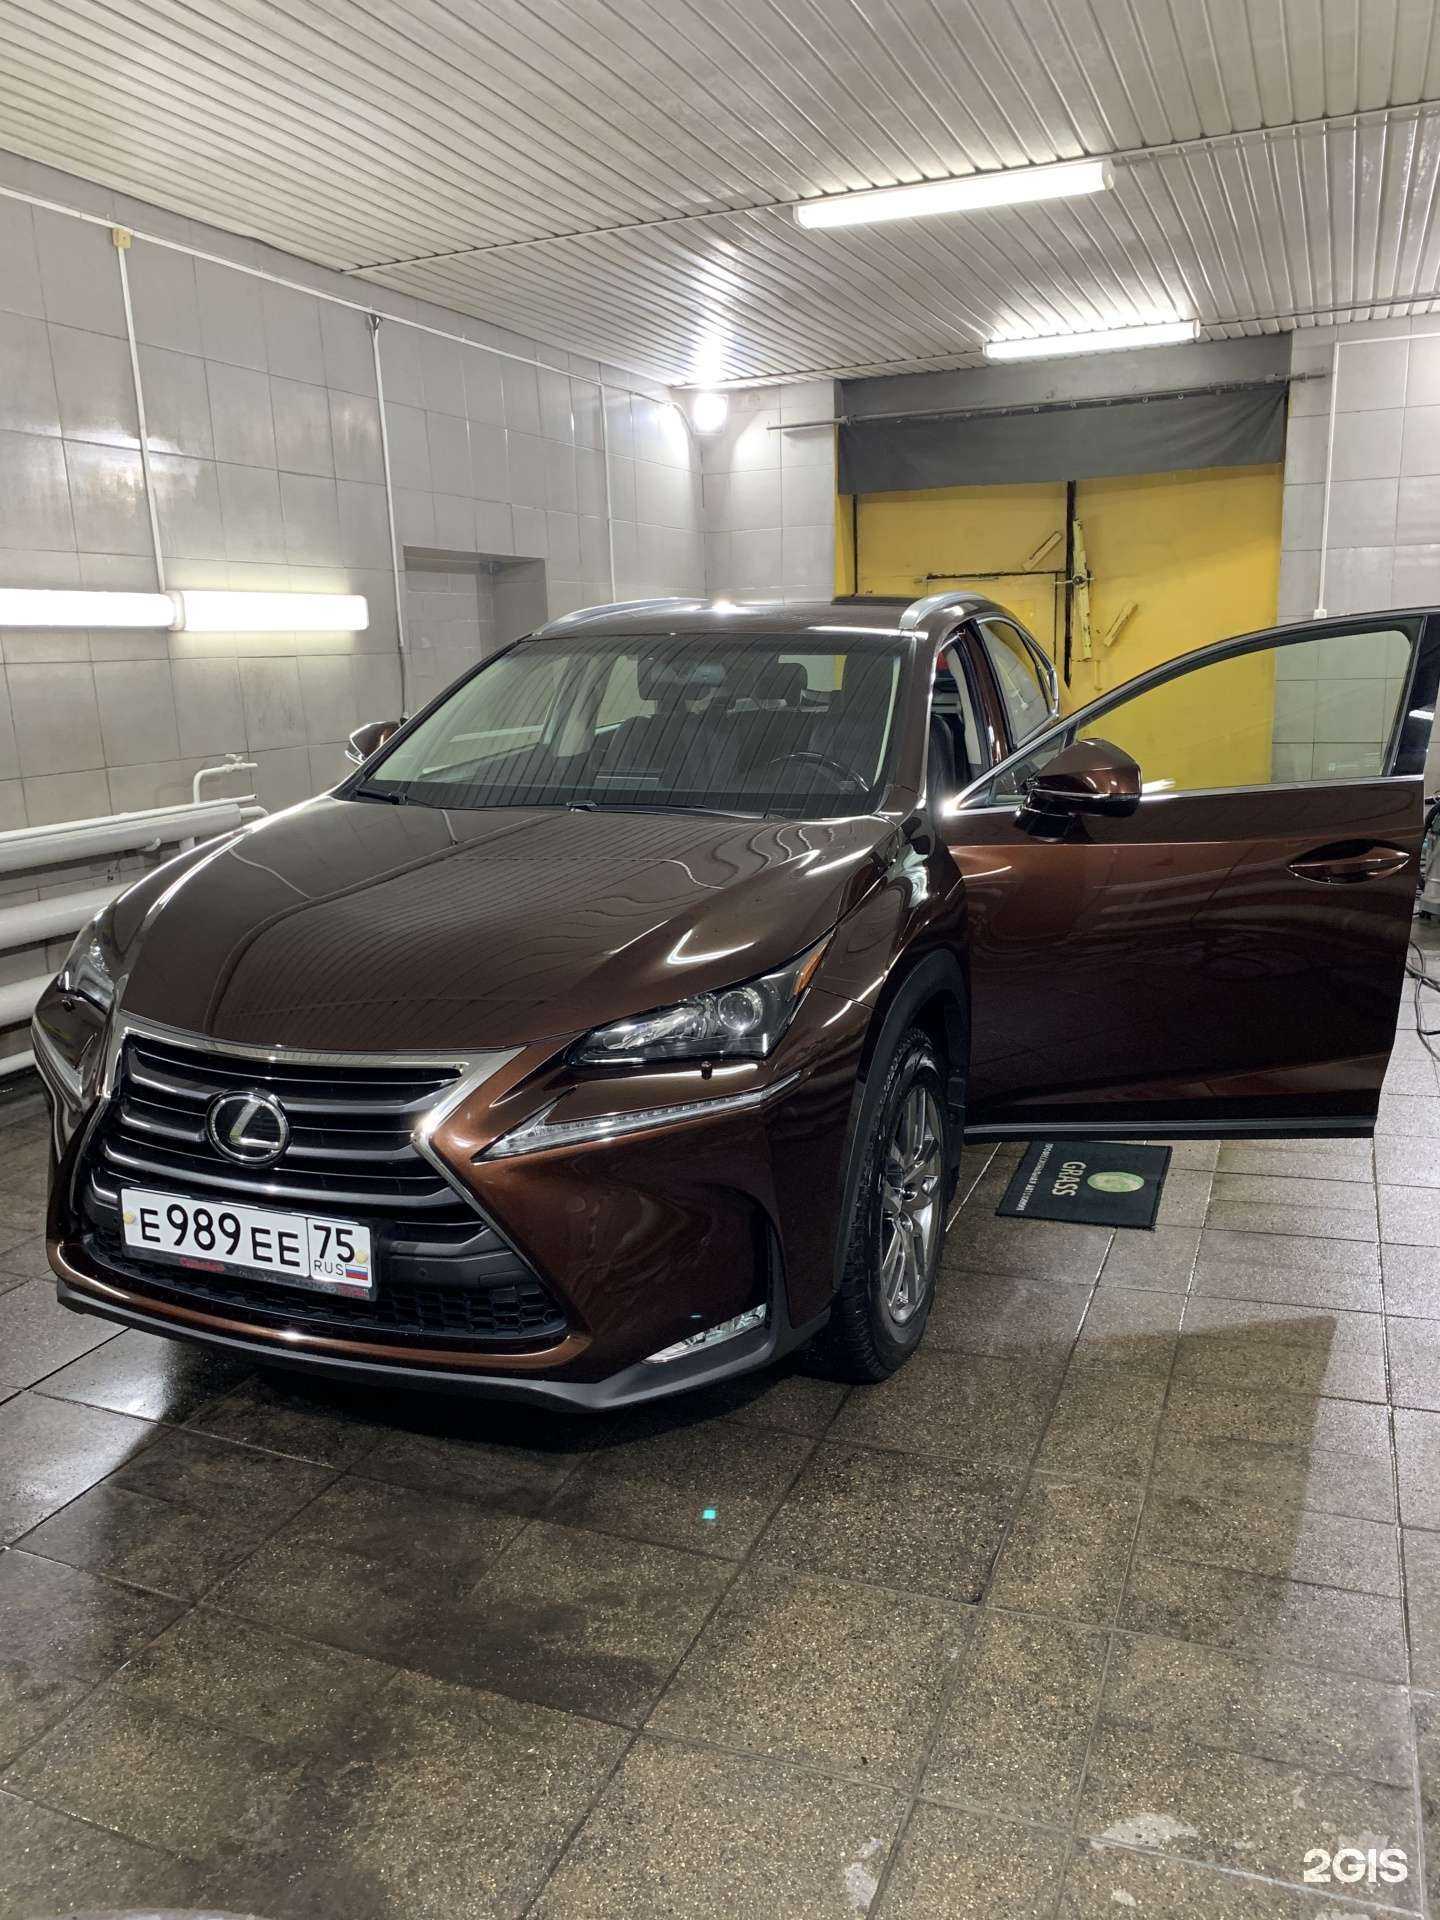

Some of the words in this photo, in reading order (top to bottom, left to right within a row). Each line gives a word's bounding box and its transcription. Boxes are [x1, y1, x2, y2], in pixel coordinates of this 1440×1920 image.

[1052, 1161, 1087, 1197] GRASS
[313, 1224, 355, 1263] 75
[314, 1260, 344, 1276] RUS
